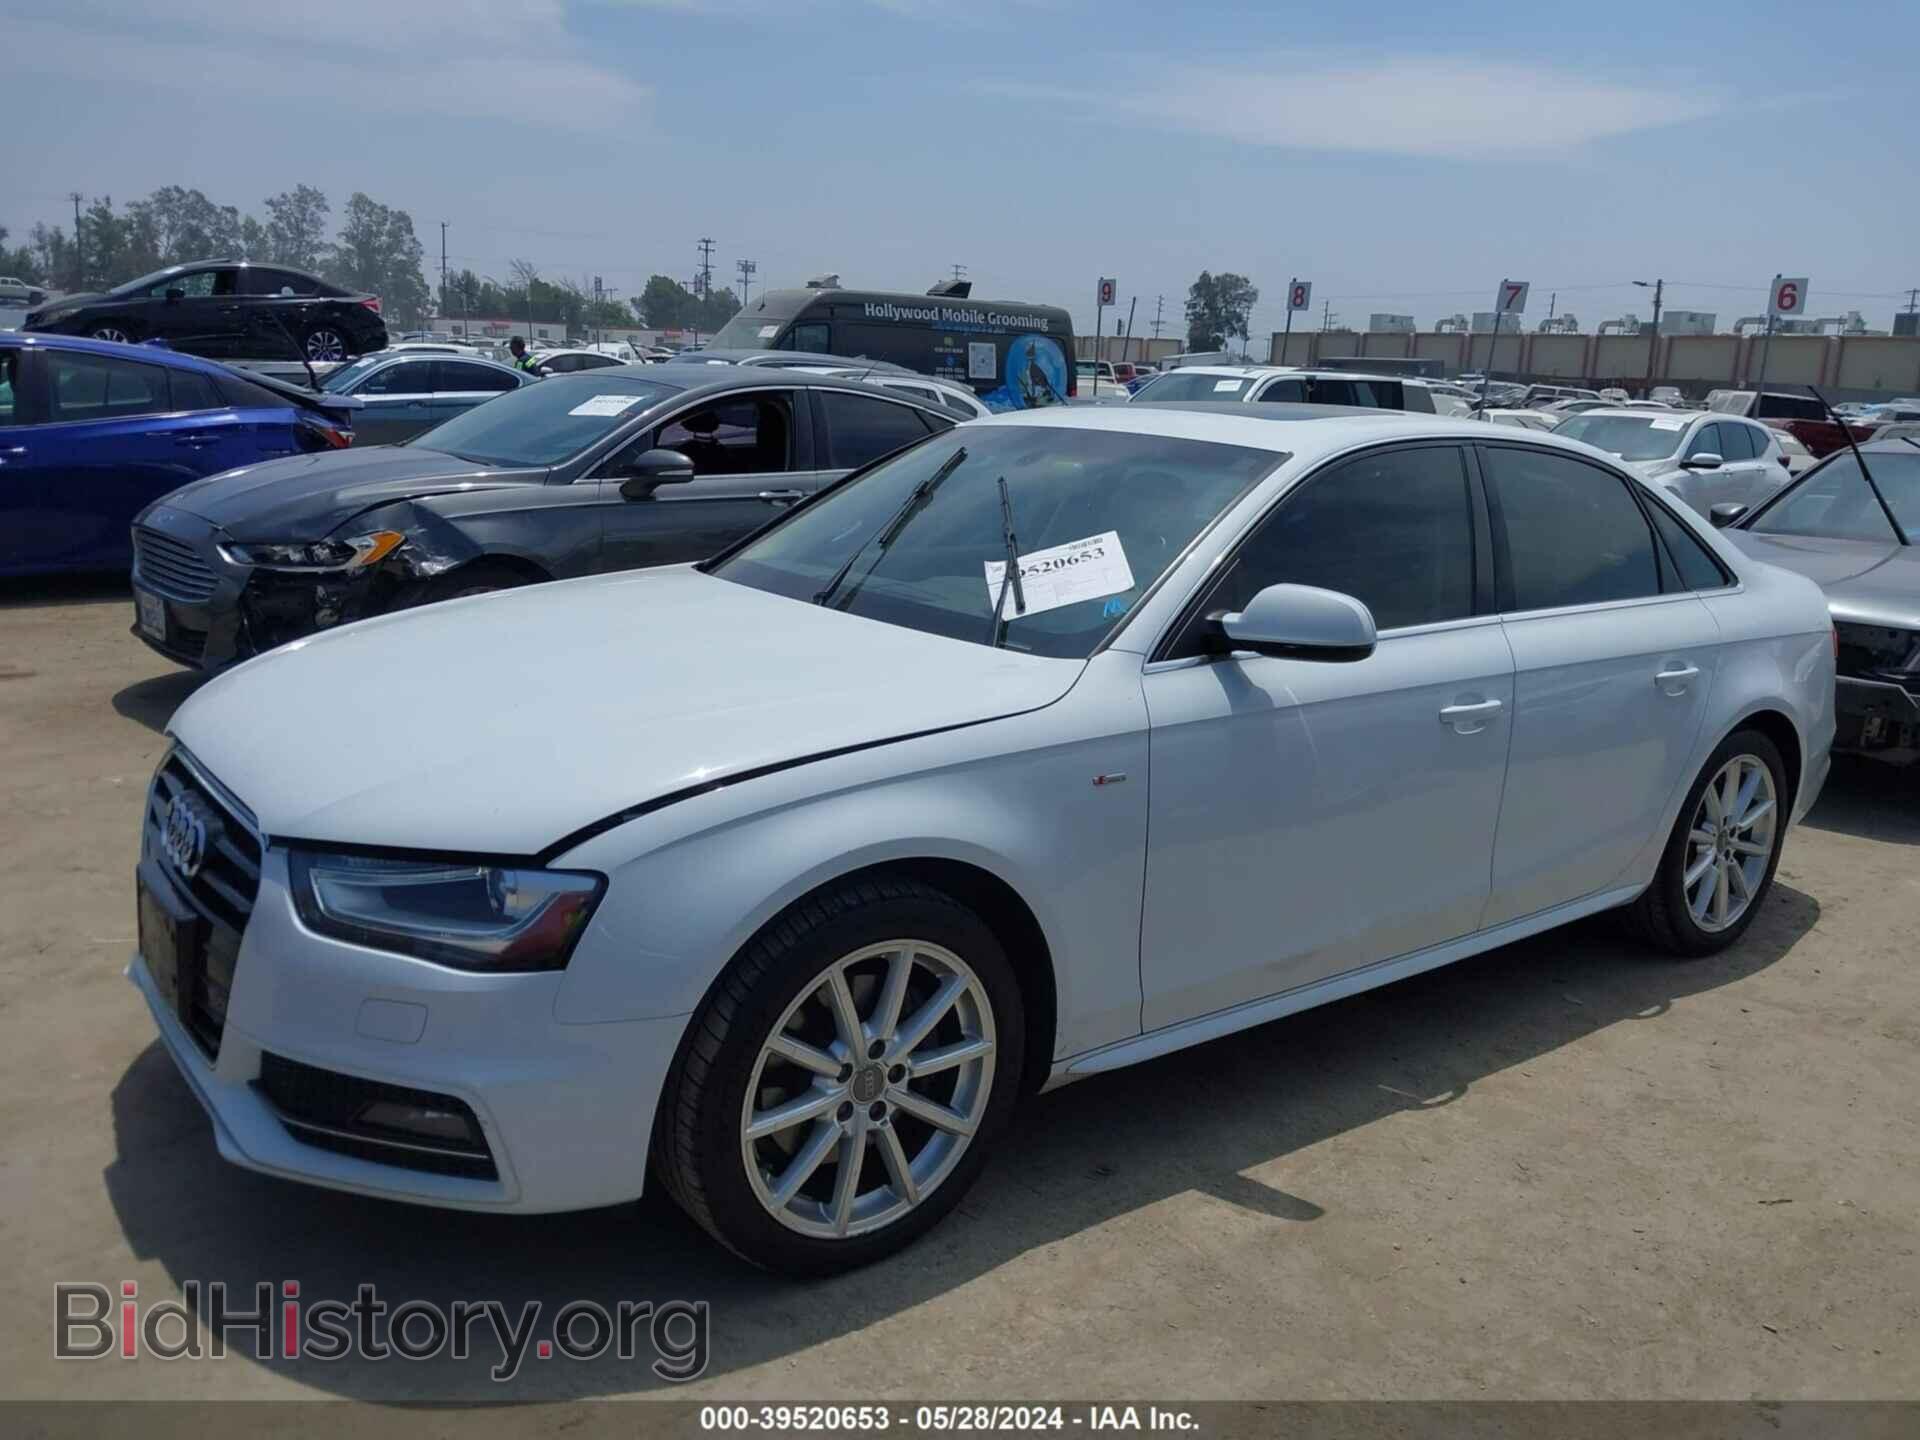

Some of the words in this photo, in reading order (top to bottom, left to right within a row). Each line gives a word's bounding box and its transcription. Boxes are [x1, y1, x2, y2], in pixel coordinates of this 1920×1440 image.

[1101, 281, 1112, 303] 9
[1291, 284, 1306, 308] 8
[1503, 284, 1522, 310] 7
[1776, 283, 1798, 311] 6
[864, 302, 939, 321] Hollywood
[941, 308, 986, 324] Mobile
[987, 311, 1049, 331] Grooming
